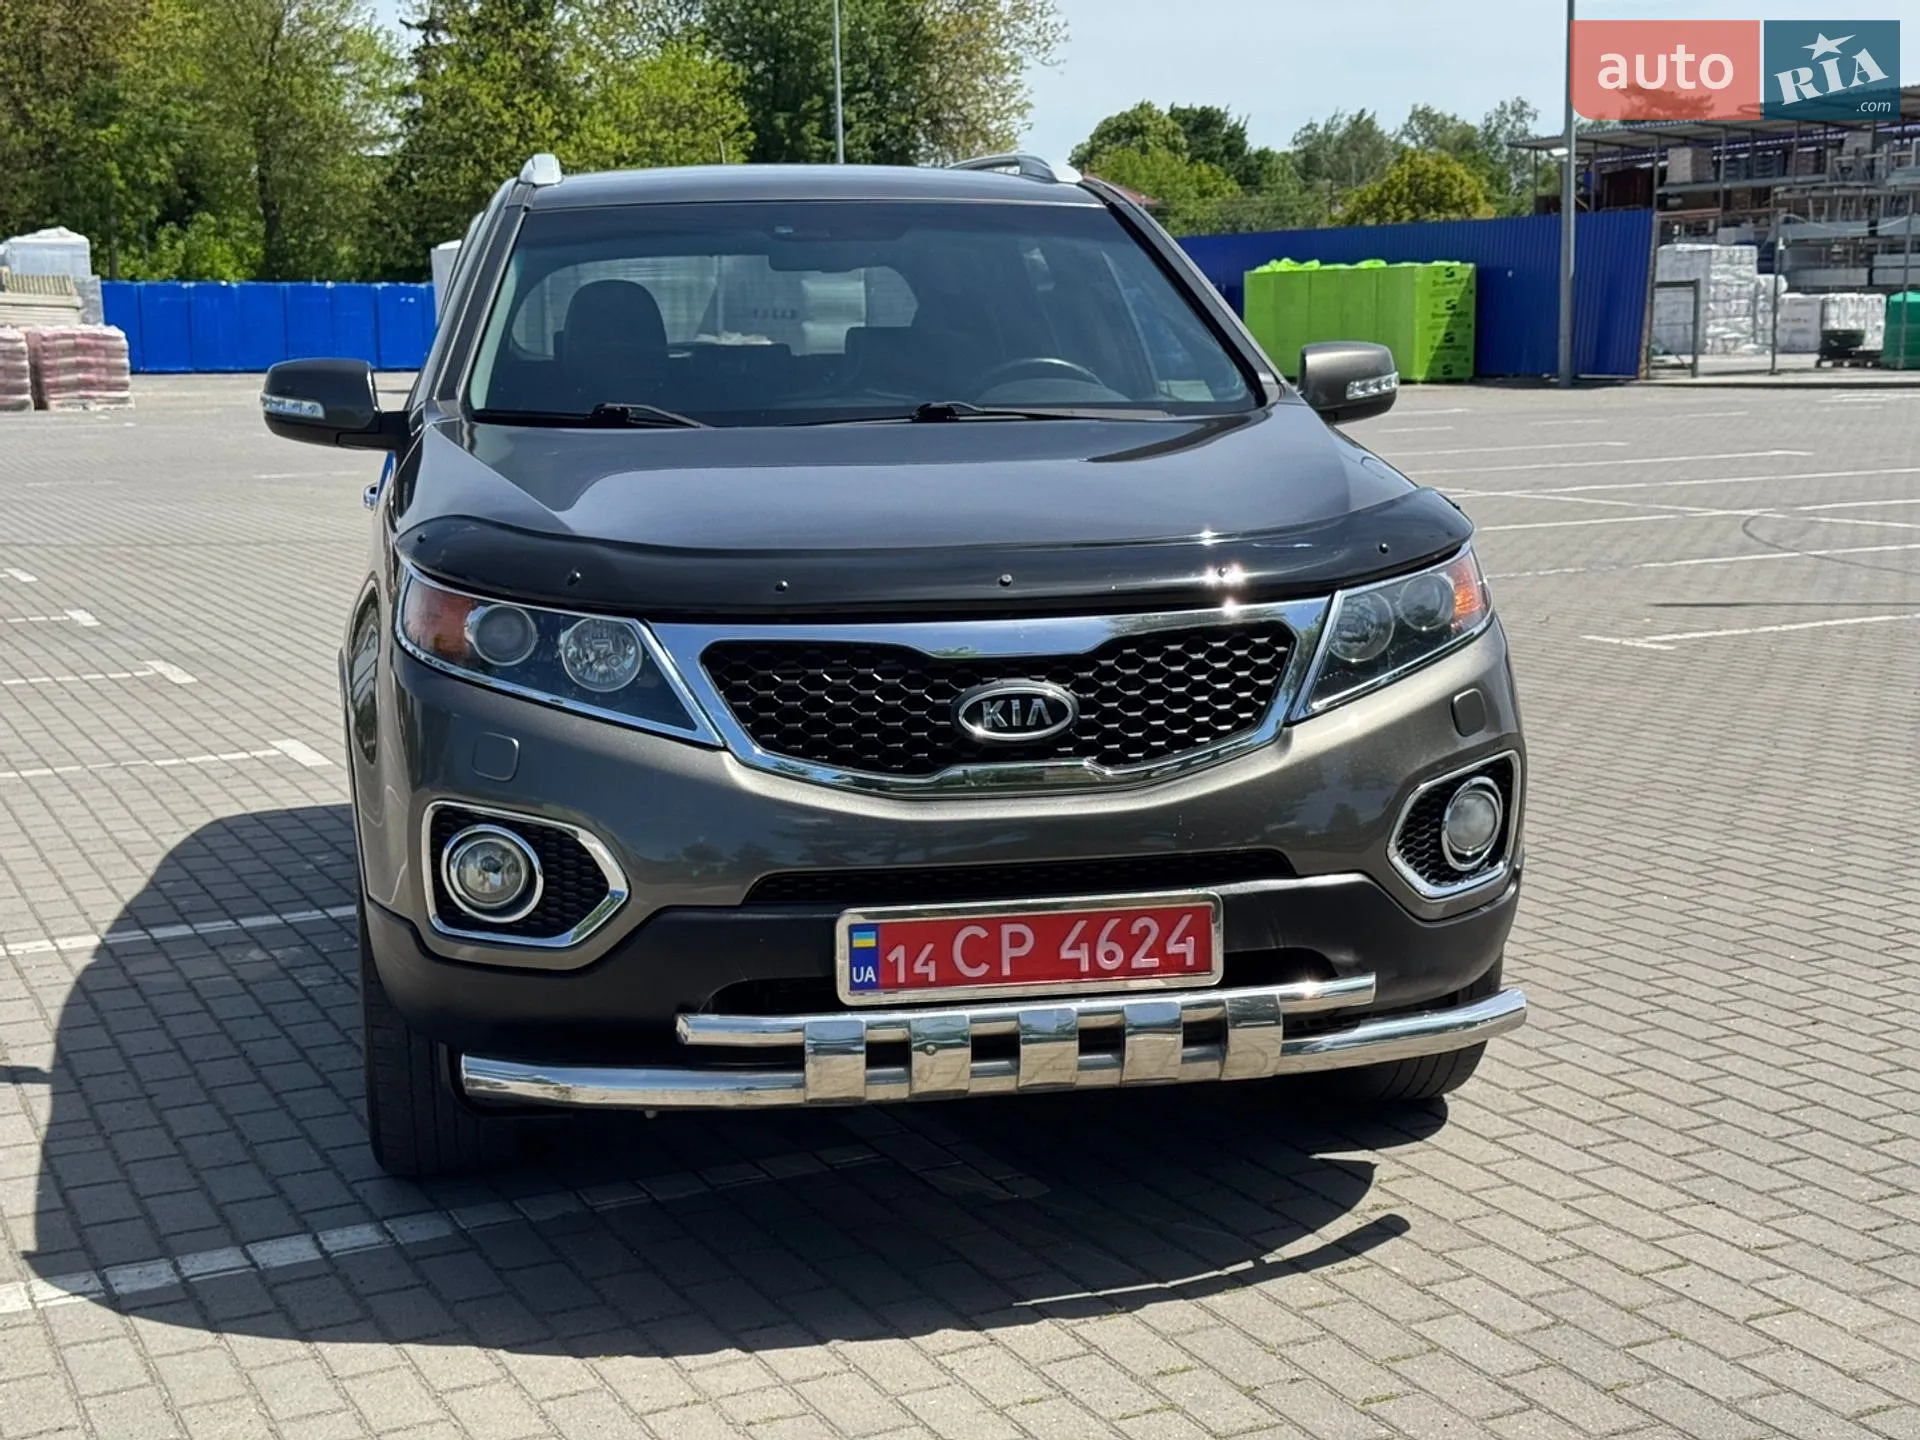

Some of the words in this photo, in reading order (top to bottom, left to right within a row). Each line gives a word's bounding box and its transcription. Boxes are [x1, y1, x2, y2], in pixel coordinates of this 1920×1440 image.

[981, 698, 1053, 729] KIA
[886, 943, 936, 983] 14
[952, 923, 1035, 978] CP
[1059, 914, 1195, 972] 4624
[852, 966, 877, 983] UA
